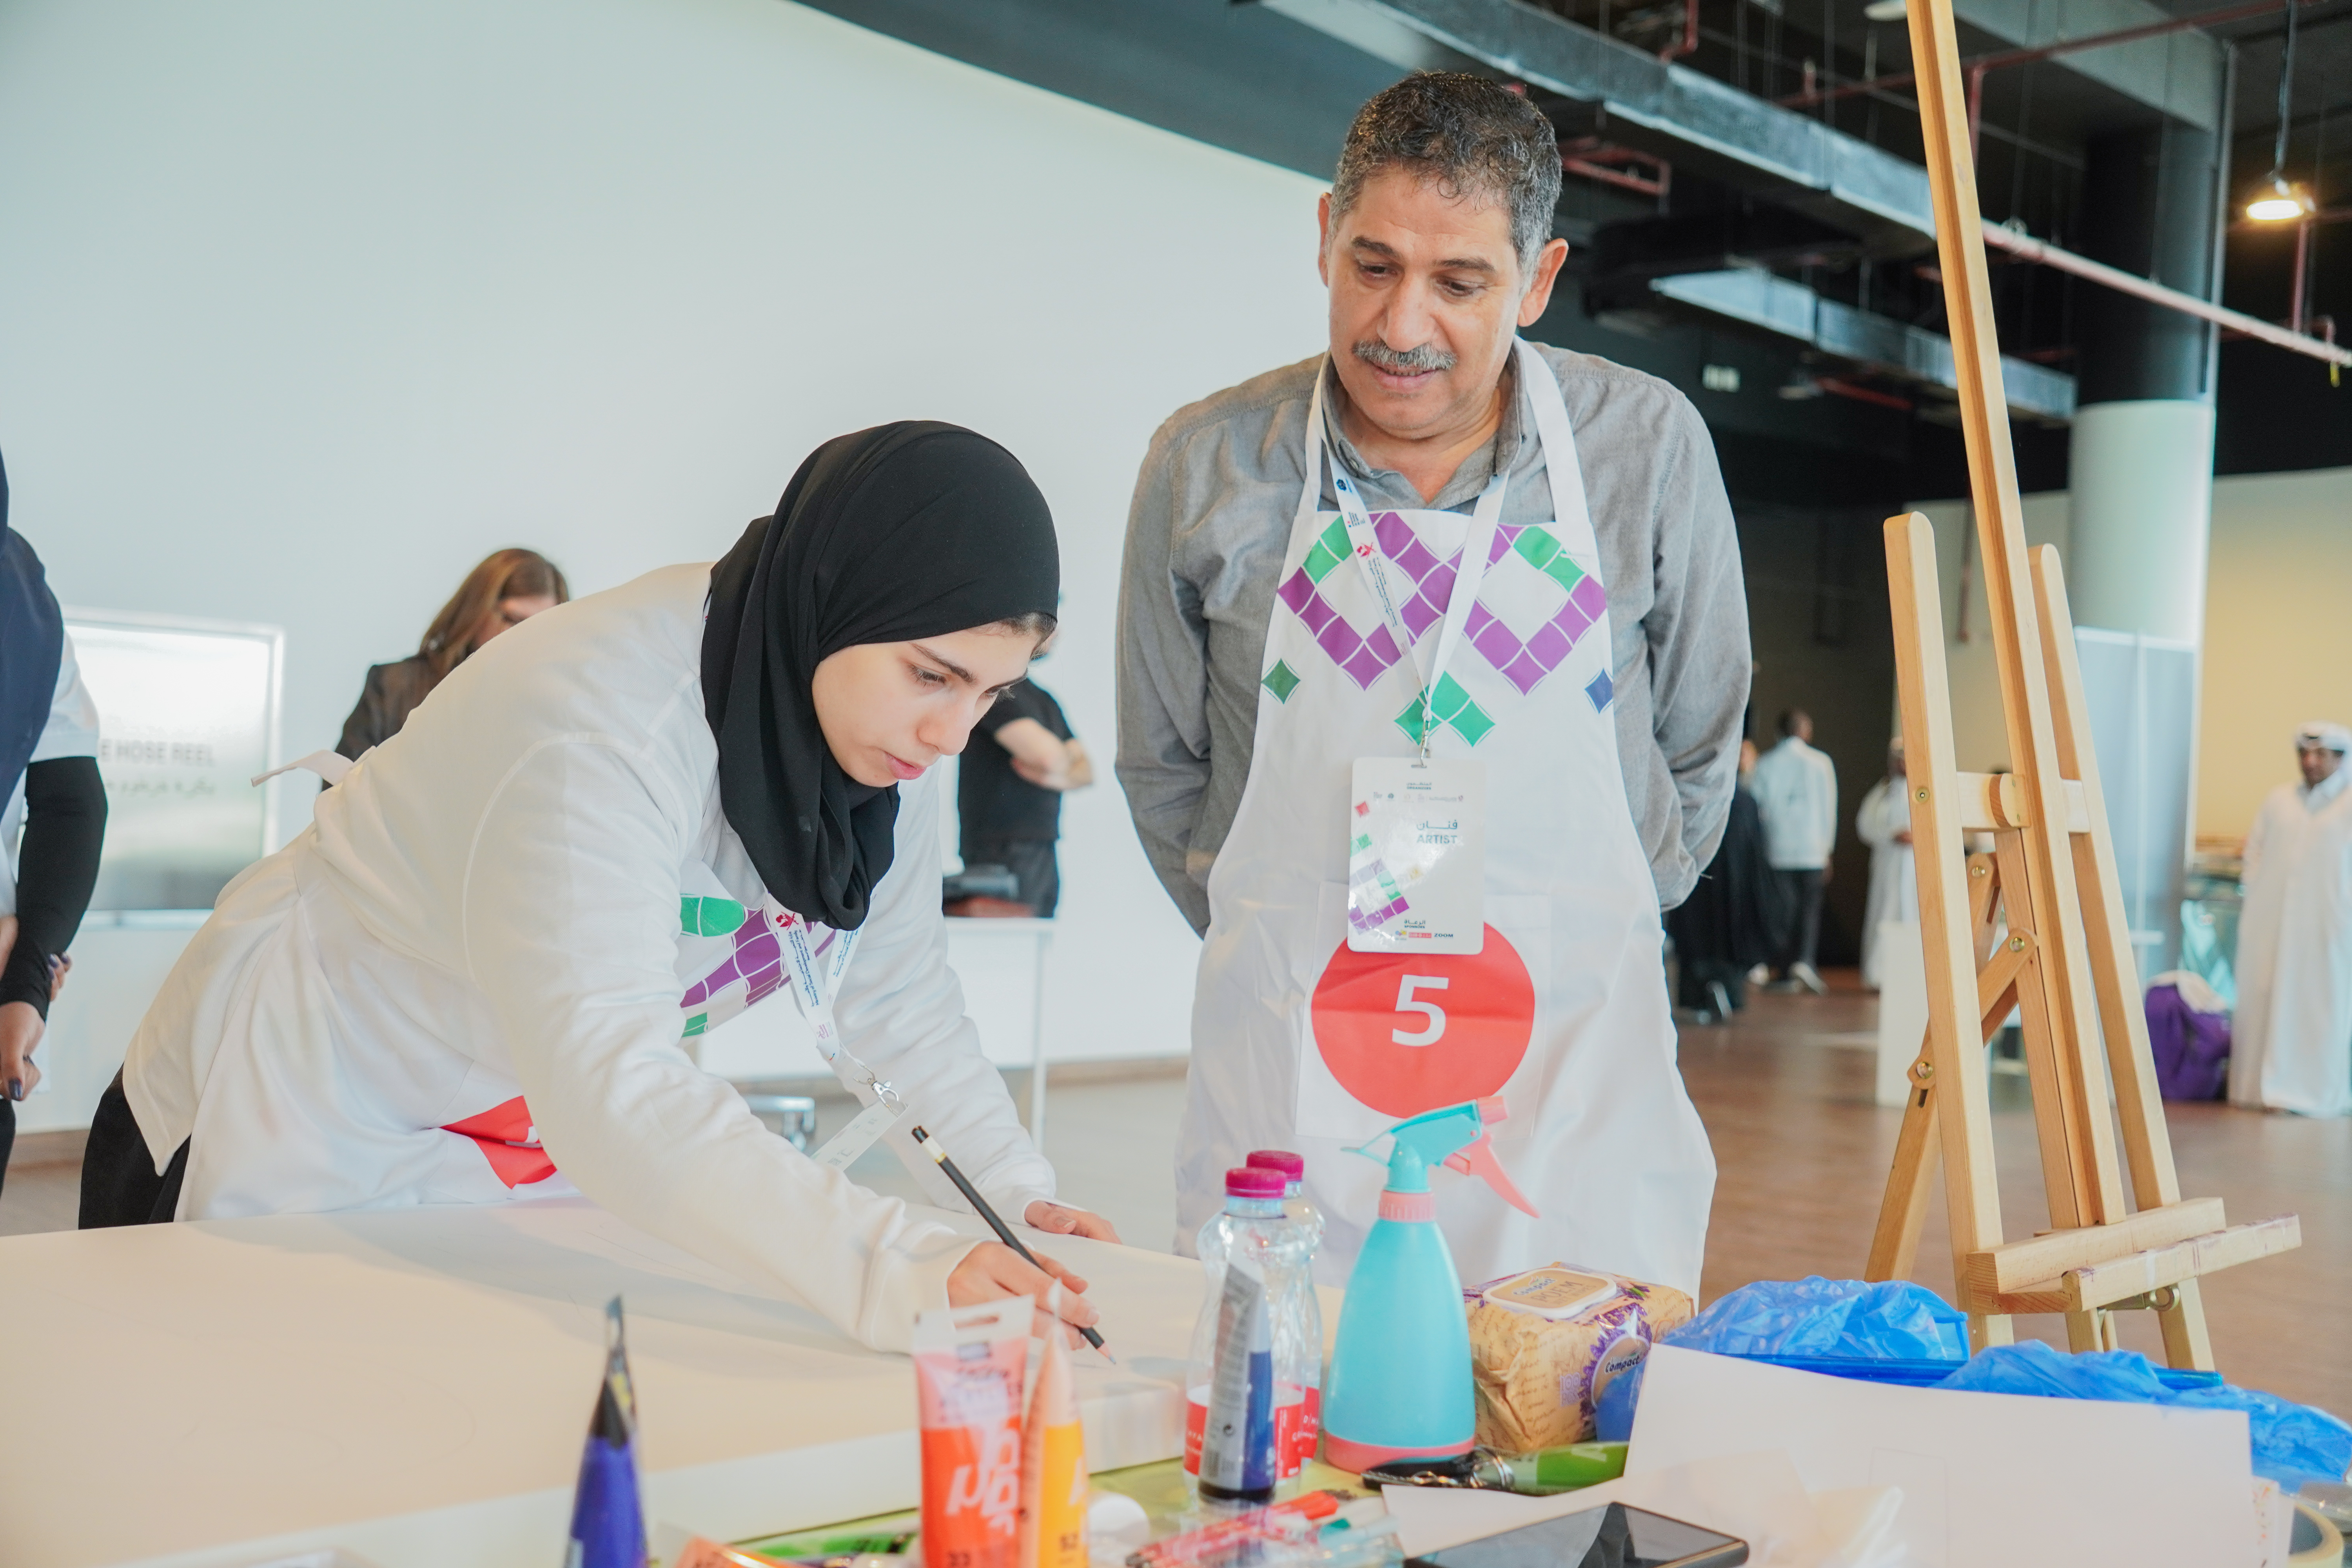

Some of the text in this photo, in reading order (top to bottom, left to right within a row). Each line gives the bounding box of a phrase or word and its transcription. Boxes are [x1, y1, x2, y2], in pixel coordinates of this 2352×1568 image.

[117, 739, 167, 765] HOSE
[172, 742, 215, 767] REEL
[1417, 835, 1457, 844] ARTIST
[1392, 975, 1449, 1047] 5
[1531, 1281, 1583, 1302] POEM
[1605, 1356, 1639, 1372] Compact
[1560, 1372, 1581, 1391] 100
